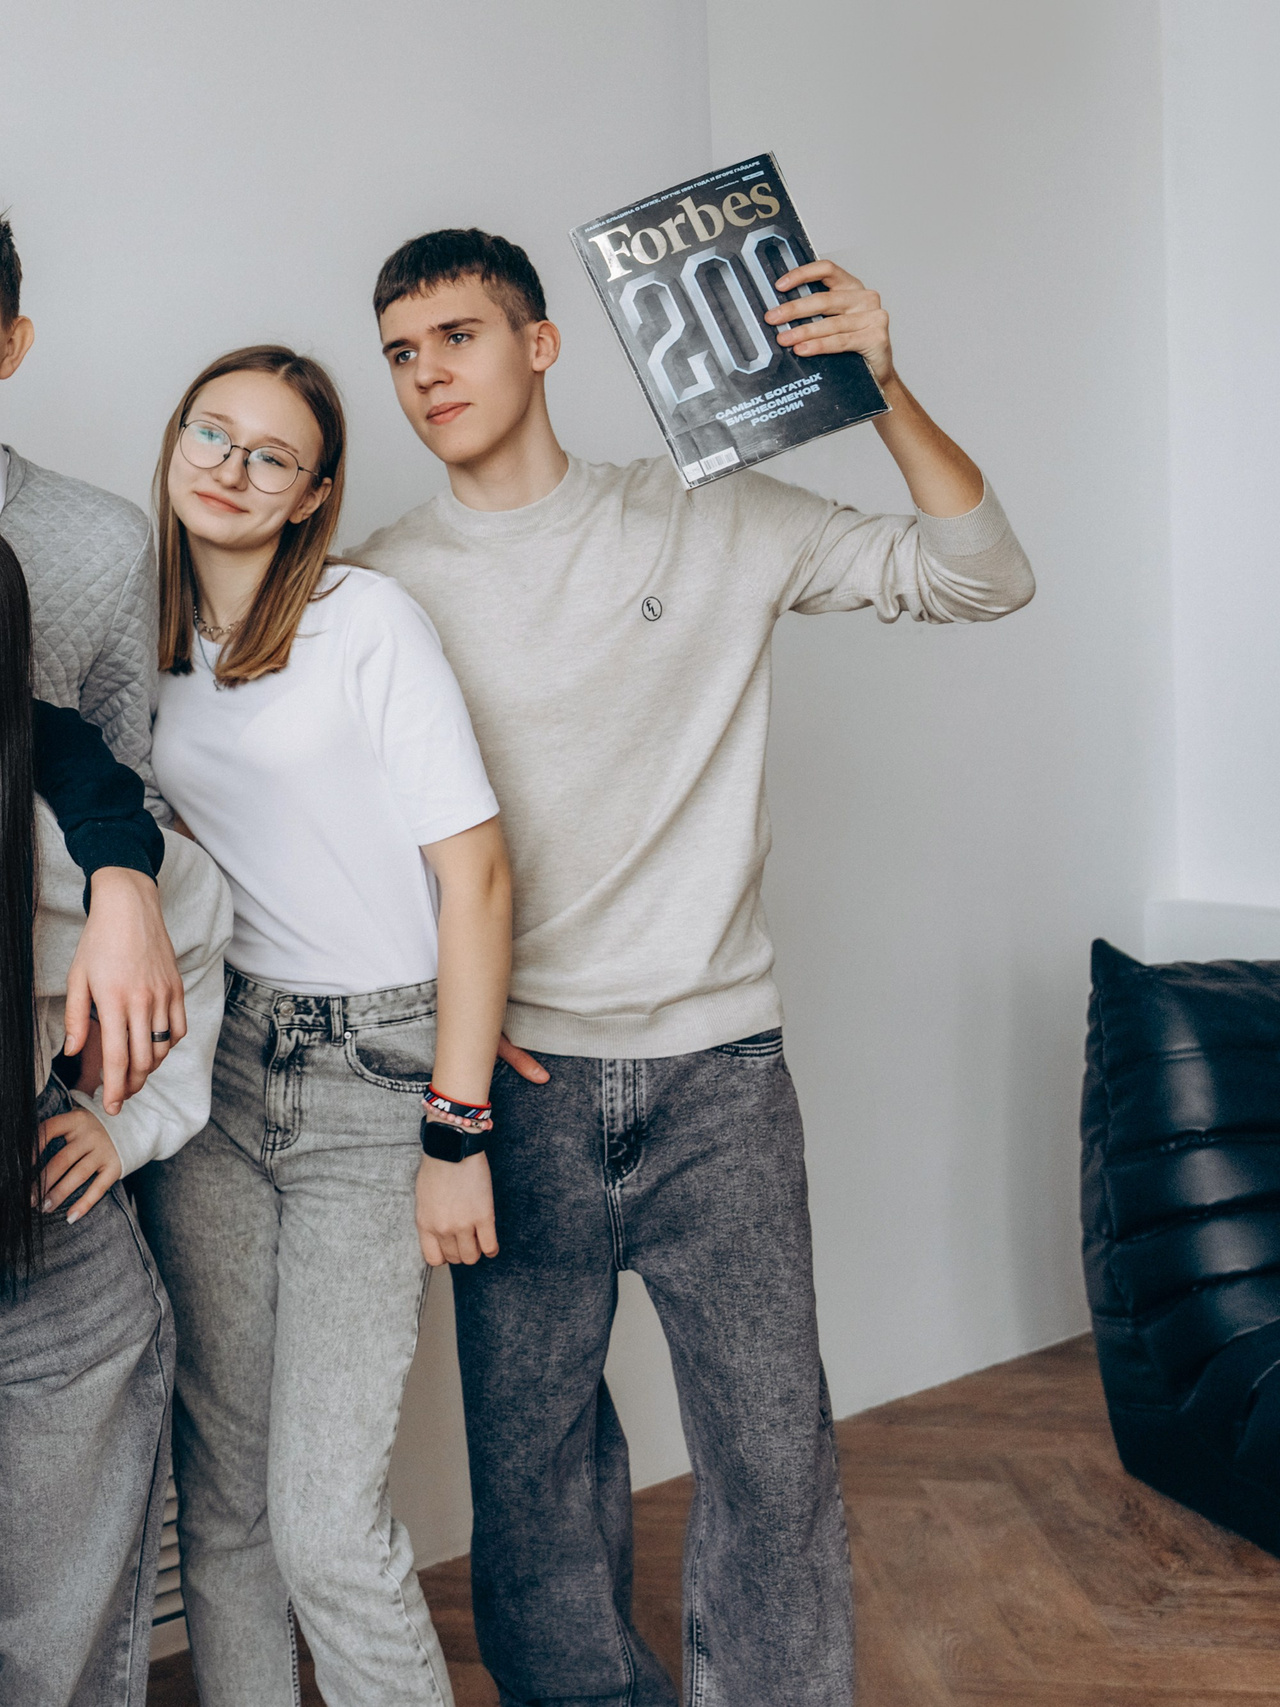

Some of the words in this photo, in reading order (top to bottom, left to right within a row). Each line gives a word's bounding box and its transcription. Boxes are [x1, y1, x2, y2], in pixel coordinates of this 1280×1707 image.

[606, 209, 635, 224] ЕЛЬЦИНА
[661, 189, 681, 201] ПУТЧЕ
[694, 178, 710, 188] ГОДА
[715, 169, 734, 180] ЕГОРЕ
[734, 160, 760, 174] ГАЙДАРЕ
[588, 182, 781, 282] Forbes
[619, 224, 824, 415] 200
[715, 394, 764, 420] САМЫХ
[764, 372, 823, 401] БОГАТЫХ
[725, 383, 821, 427] БИЗНЕСМЕНОВ
[750, 400, 804, 427] РОССИИ
[431, 1097, 452, 1113] M
